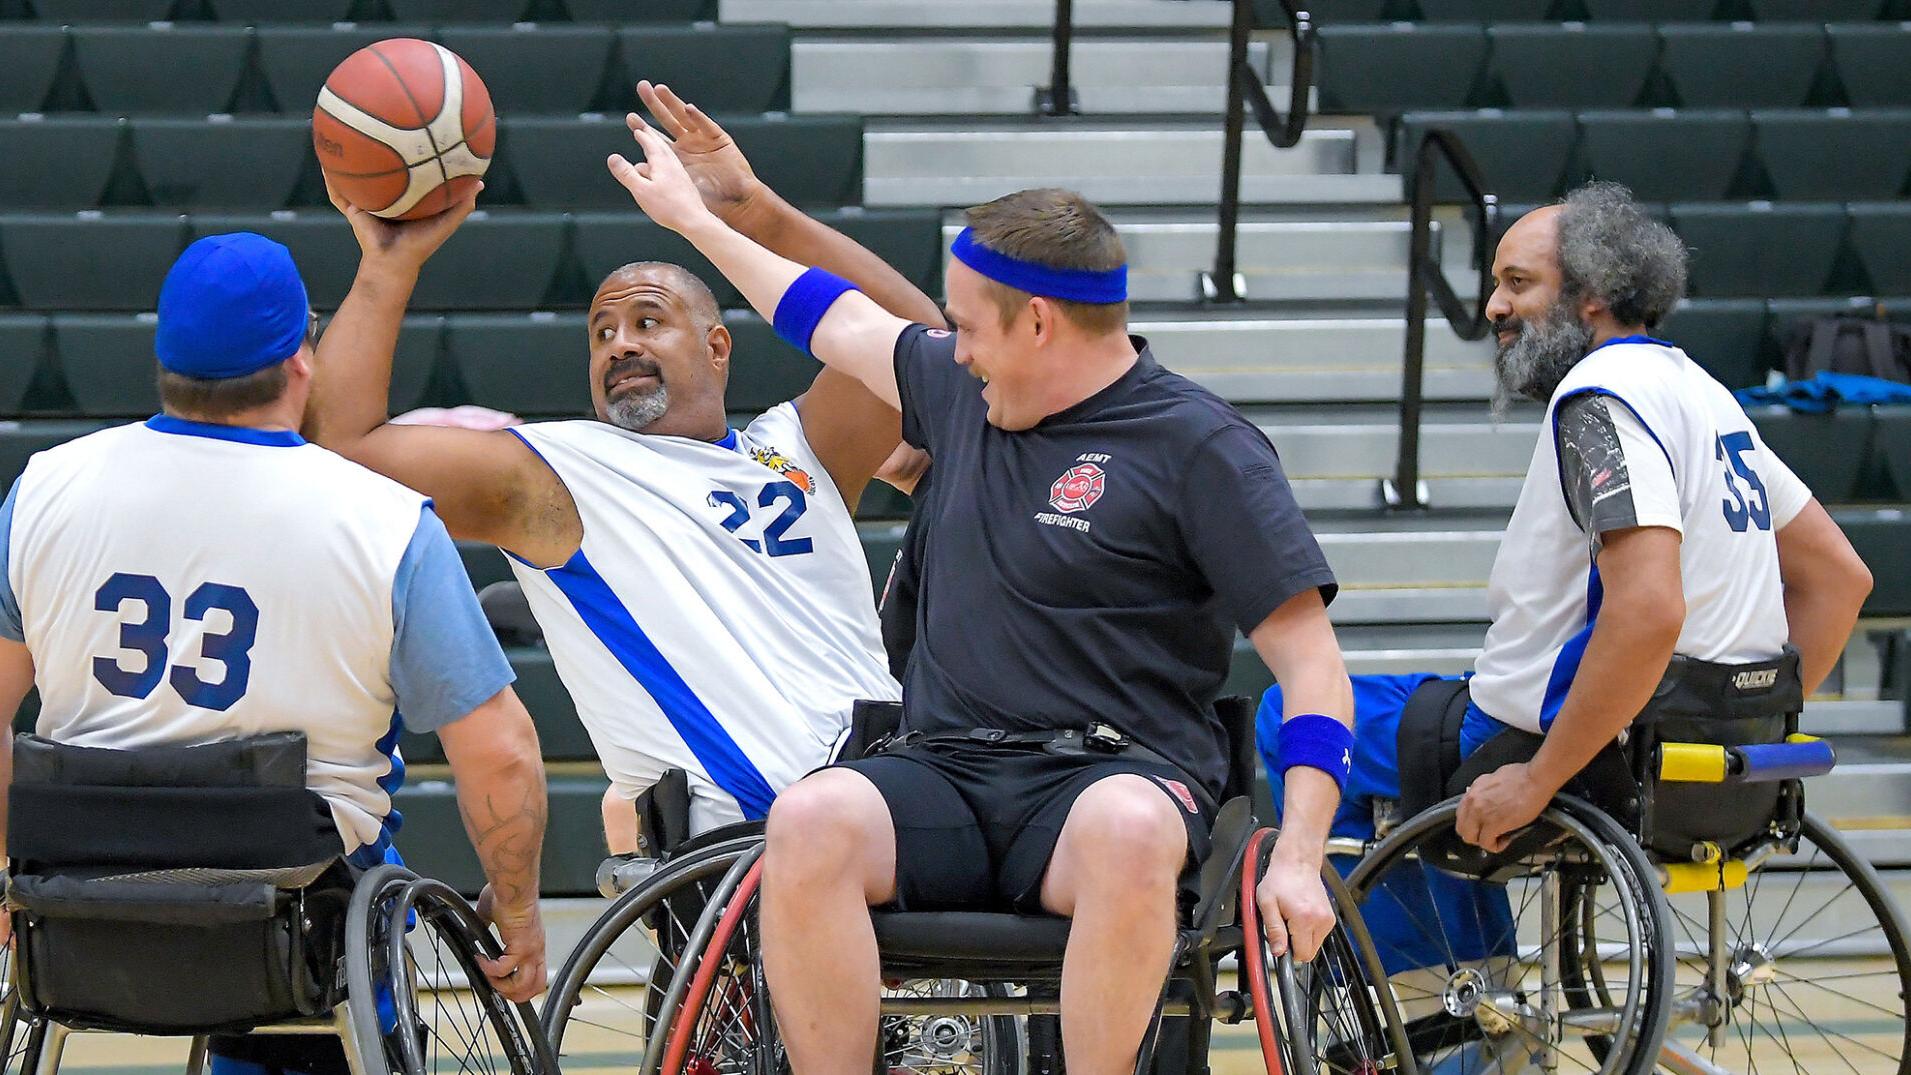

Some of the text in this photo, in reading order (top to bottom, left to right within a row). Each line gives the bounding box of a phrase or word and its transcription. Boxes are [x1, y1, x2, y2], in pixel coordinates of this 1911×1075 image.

[1076, 453, 1112, 463] AEMT
[1715, 430, 1770, 532] 35
[706, 481, 813, 557] 22
[1034, 513, 1091, 533] FIREFIGHTER
[93, 572, 259, 712] 33
